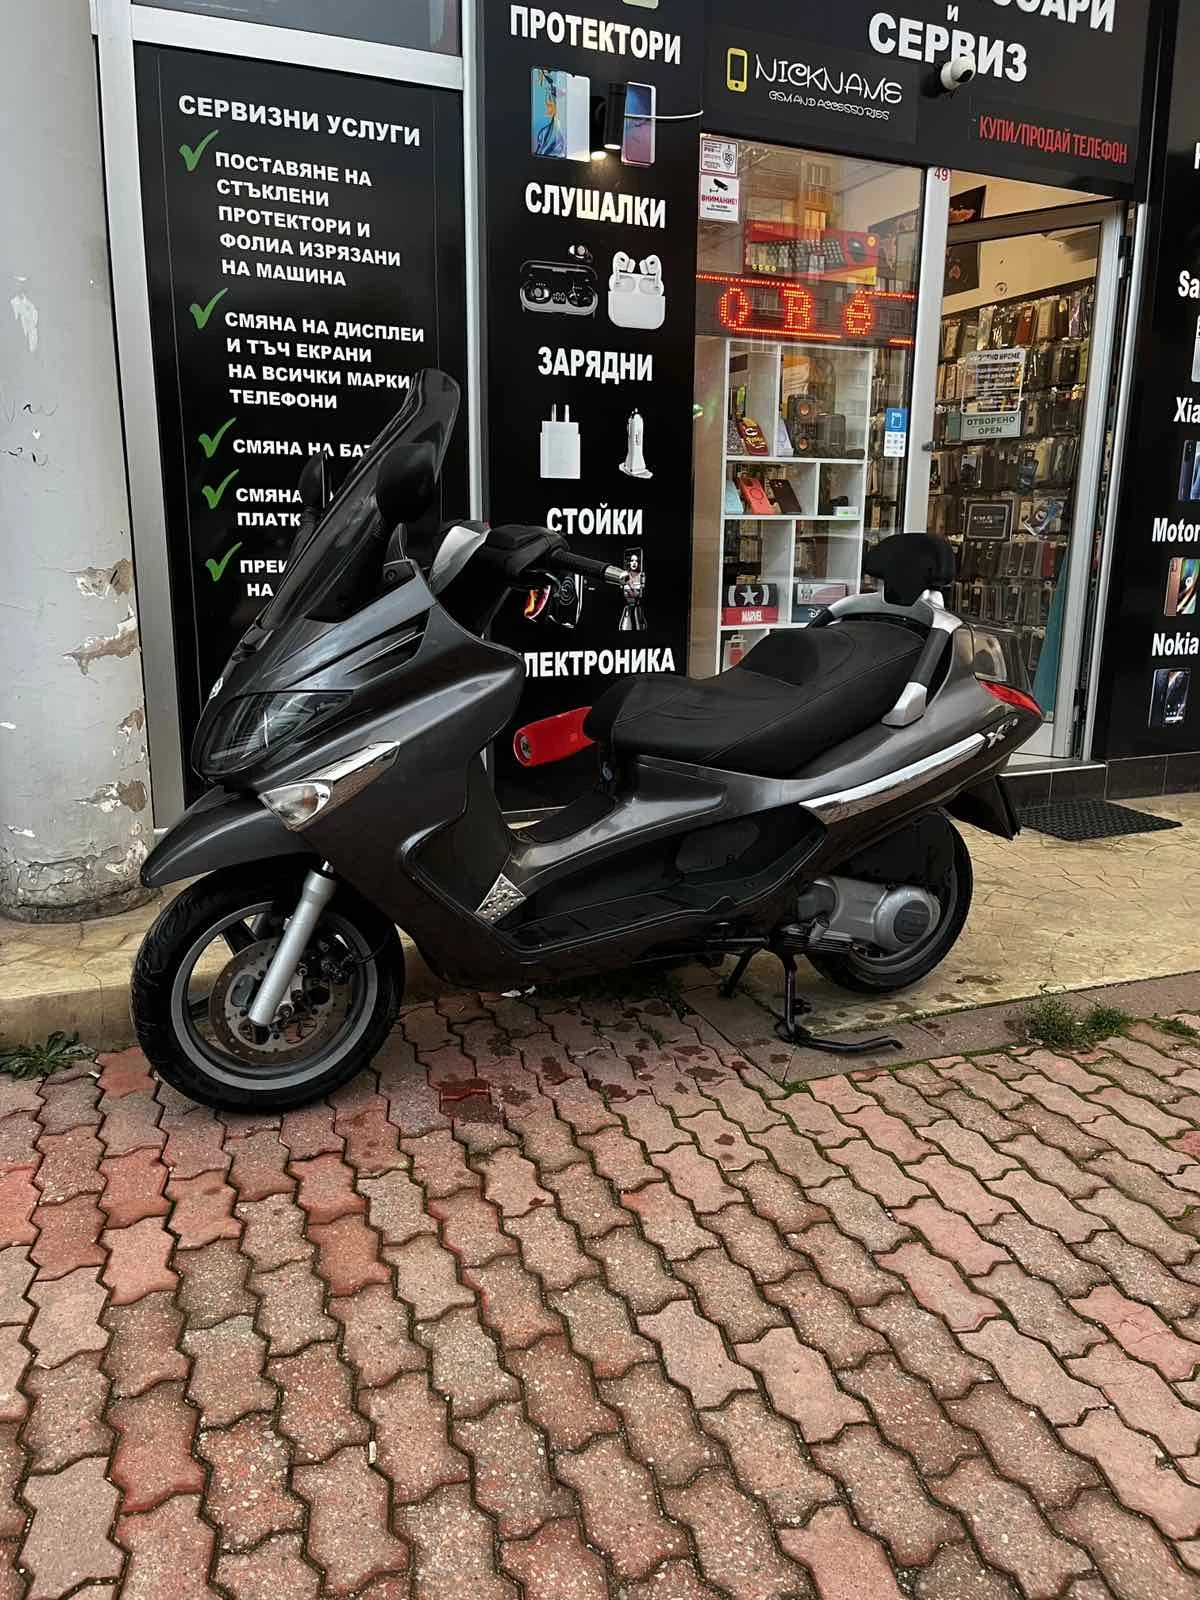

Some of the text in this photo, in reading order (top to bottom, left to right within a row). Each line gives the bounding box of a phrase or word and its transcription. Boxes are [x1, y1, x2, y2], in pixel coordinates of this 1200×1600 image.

[510, 4, 681, 65] ПРОТЕКТОРИ
[869, 12, 1027, 82] СЕРВИЗ
[755, 54, 902, 104] NICKNAME
[178, 95, 421, 147] СЕРВИЗНИ УСЛУГИ
[769, 91, 890, 121] GSM AND ACCESSORIES
[979, 115, 1129, 165] КУПИ/ПРОДАЙ ТЕЛЕФОН
[215, 151, 372, 187] ПОСТАВЯНЕ НА
[934, 168, 949, 182] 49
[216, 179, 330, 208] СТЪКЛЕНИ
[525, 182, 666, 229] СЛУШАЛКИ
[218, 205, 371, 238] ПРОТЕКТОРИ И
[219, 232, 401, 267] ФОЛИА ИЗРЯЗАНИ
[221, 259, 347, 286] НА МАШИНА
[224, 311, 425, 343] СМЯНА НА ДИСПЛЕИ
[226, 337, 372, 363] И ТЪЧ ЕКРАНИ
[537, 346, 653, 384] ЗАРЯДНИ
[228, 363, 411, 390] НА ВСИЧКИ МАРКИ
[229, 388, 338, 409] ТЕЛЕФОНИ
[978, 426, 1003, 436] OPEN
[232, 438, 303, 456] СМЯНА
[235, 487, 303, 504] СМЯНА
[237, 512, 302, 527] ПЛАТК
[546, 503, 643, 536] СТОЙКИ
[1151, 517, 1200, 543] Motor
[246, 583, 275, 598] НА
[1151, 631, 1200, 657] Nokia
[519, 648, 676, 678] ЛЕКТРОНИКА
